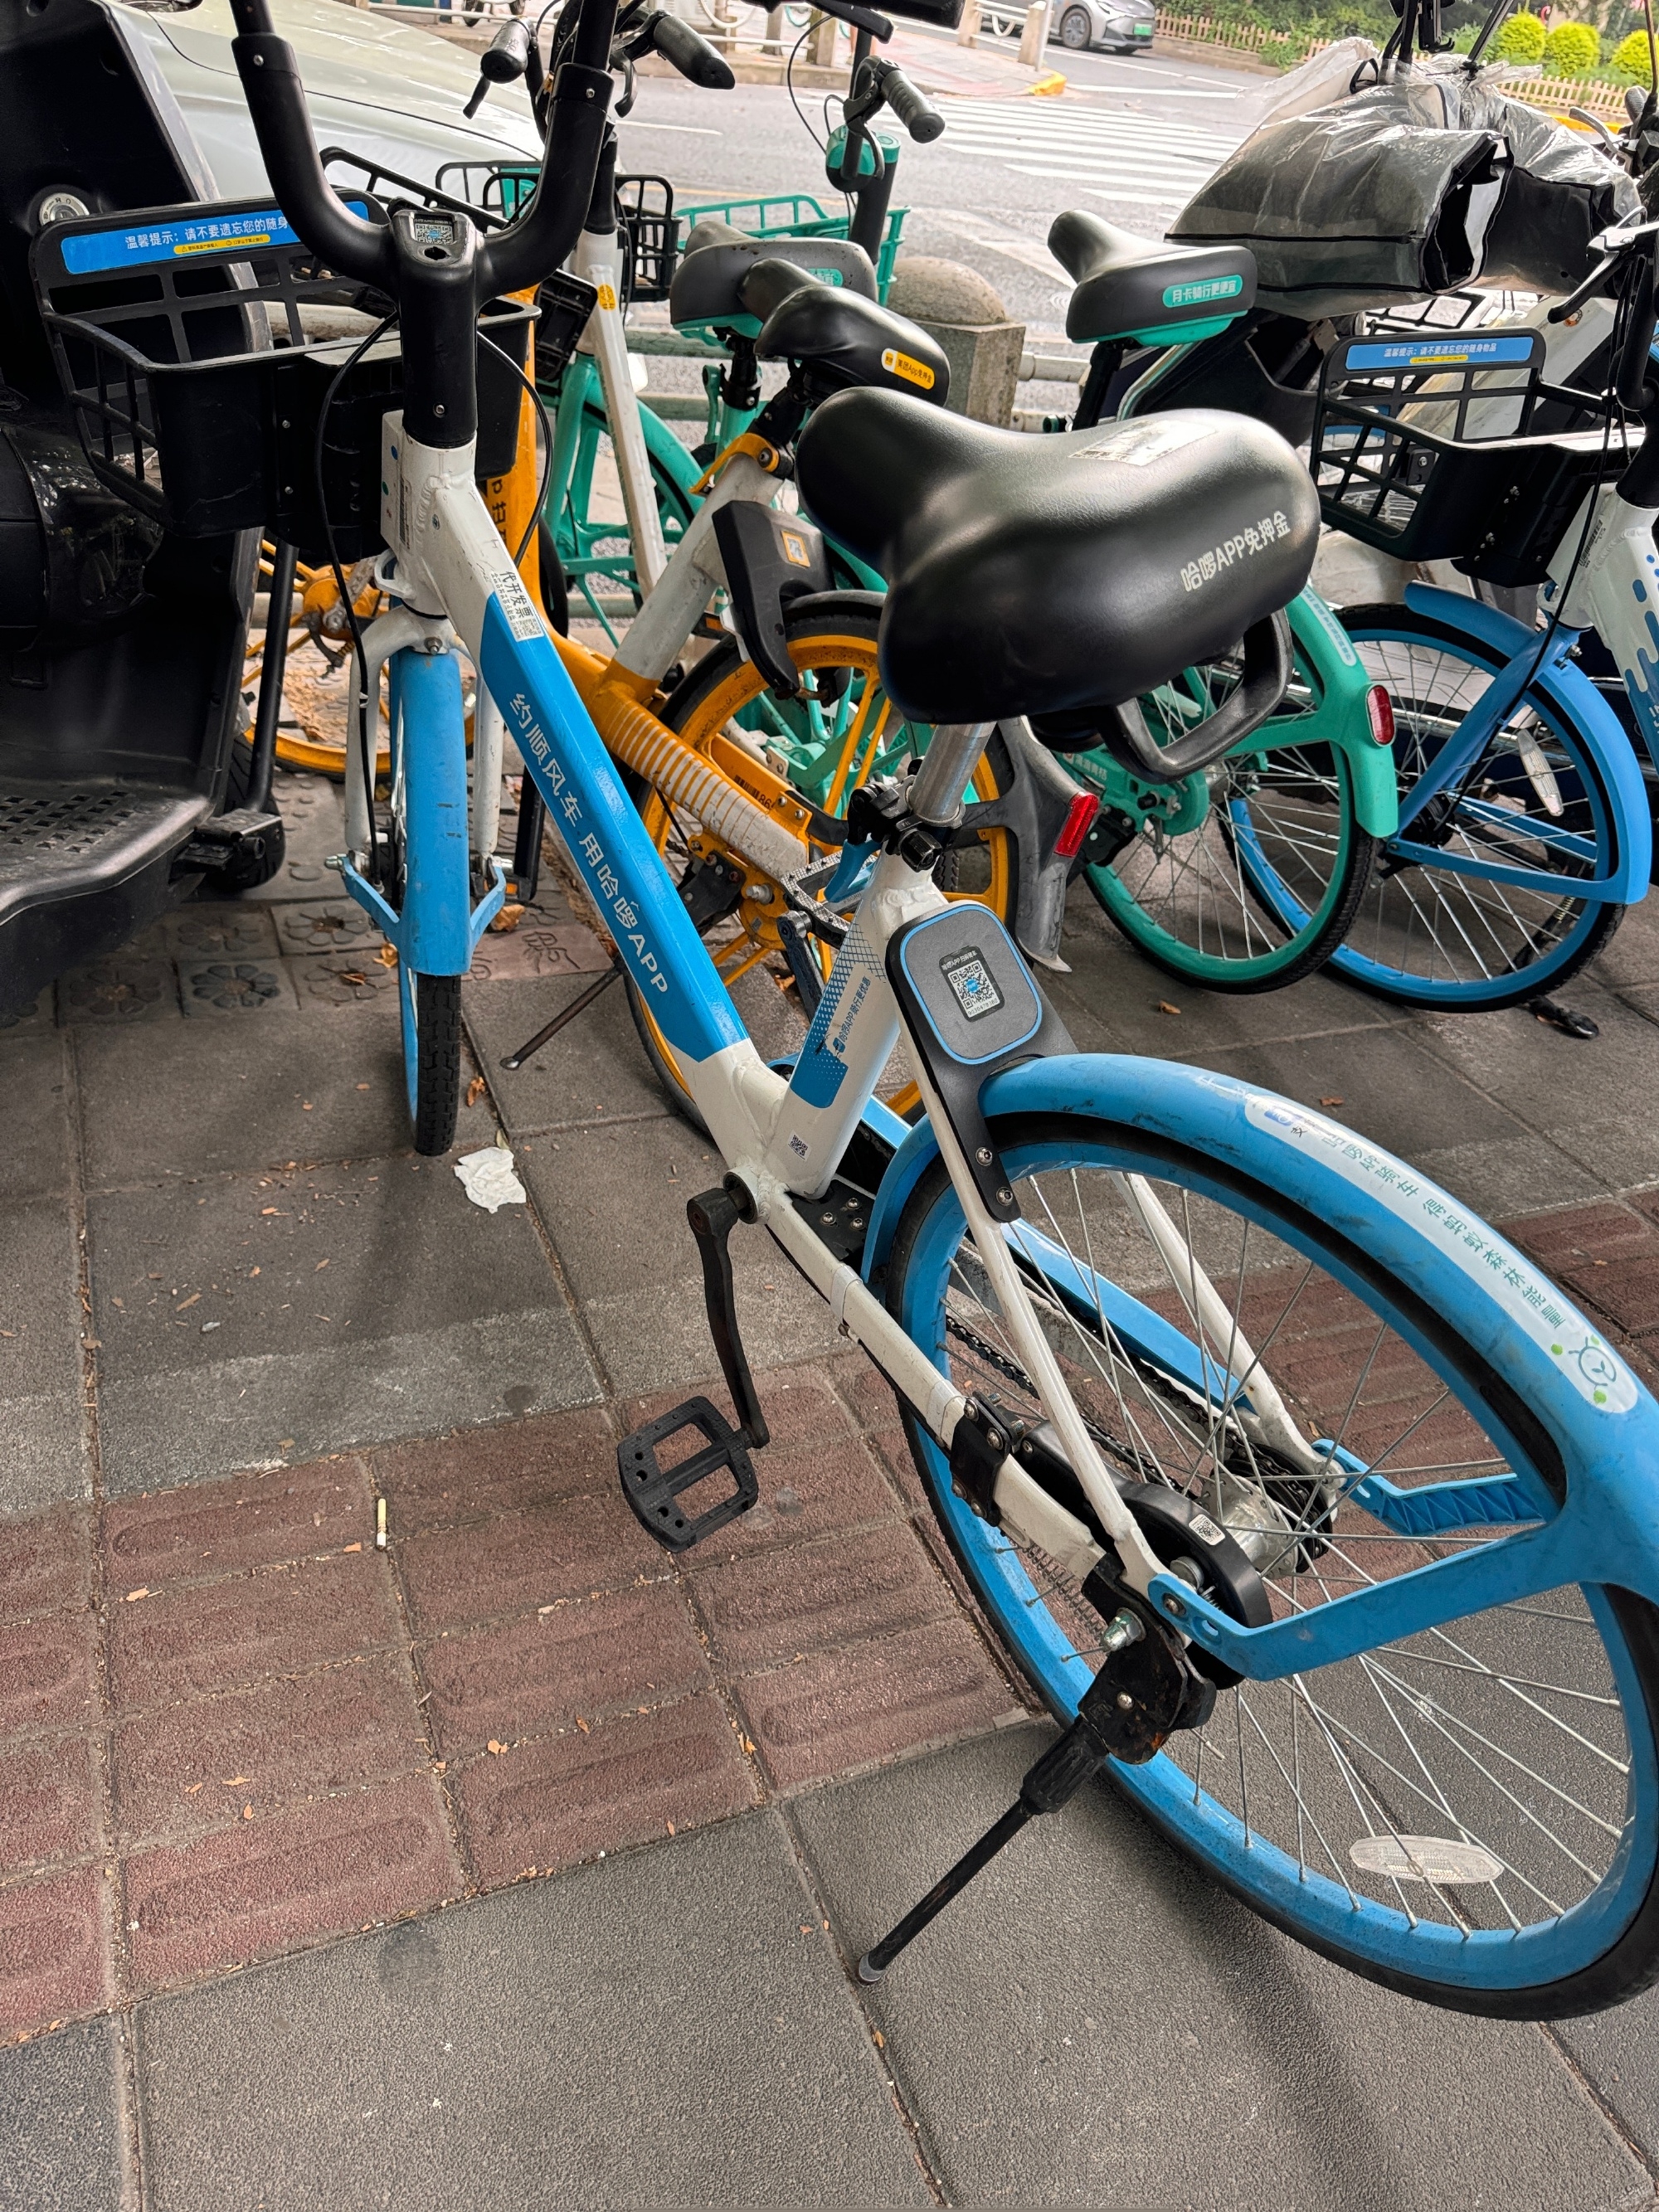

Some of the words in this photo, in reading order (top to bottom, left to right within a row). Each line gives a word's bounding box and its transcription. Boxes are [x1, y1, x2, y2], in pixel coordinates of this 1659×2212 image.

[1172, 280, 1237, 303] 月卡骑行更便宜
[1180, 510, 1291, 592] 哈啰APP免押金
[499, 571, 534, 620] 代开发票
[509, 693, 582, 829] 约顺风车
[578, 832, 669, 994] 用哈啰APP
[839, 976, 872, 1043] 哈啰APP骑行更优惠
